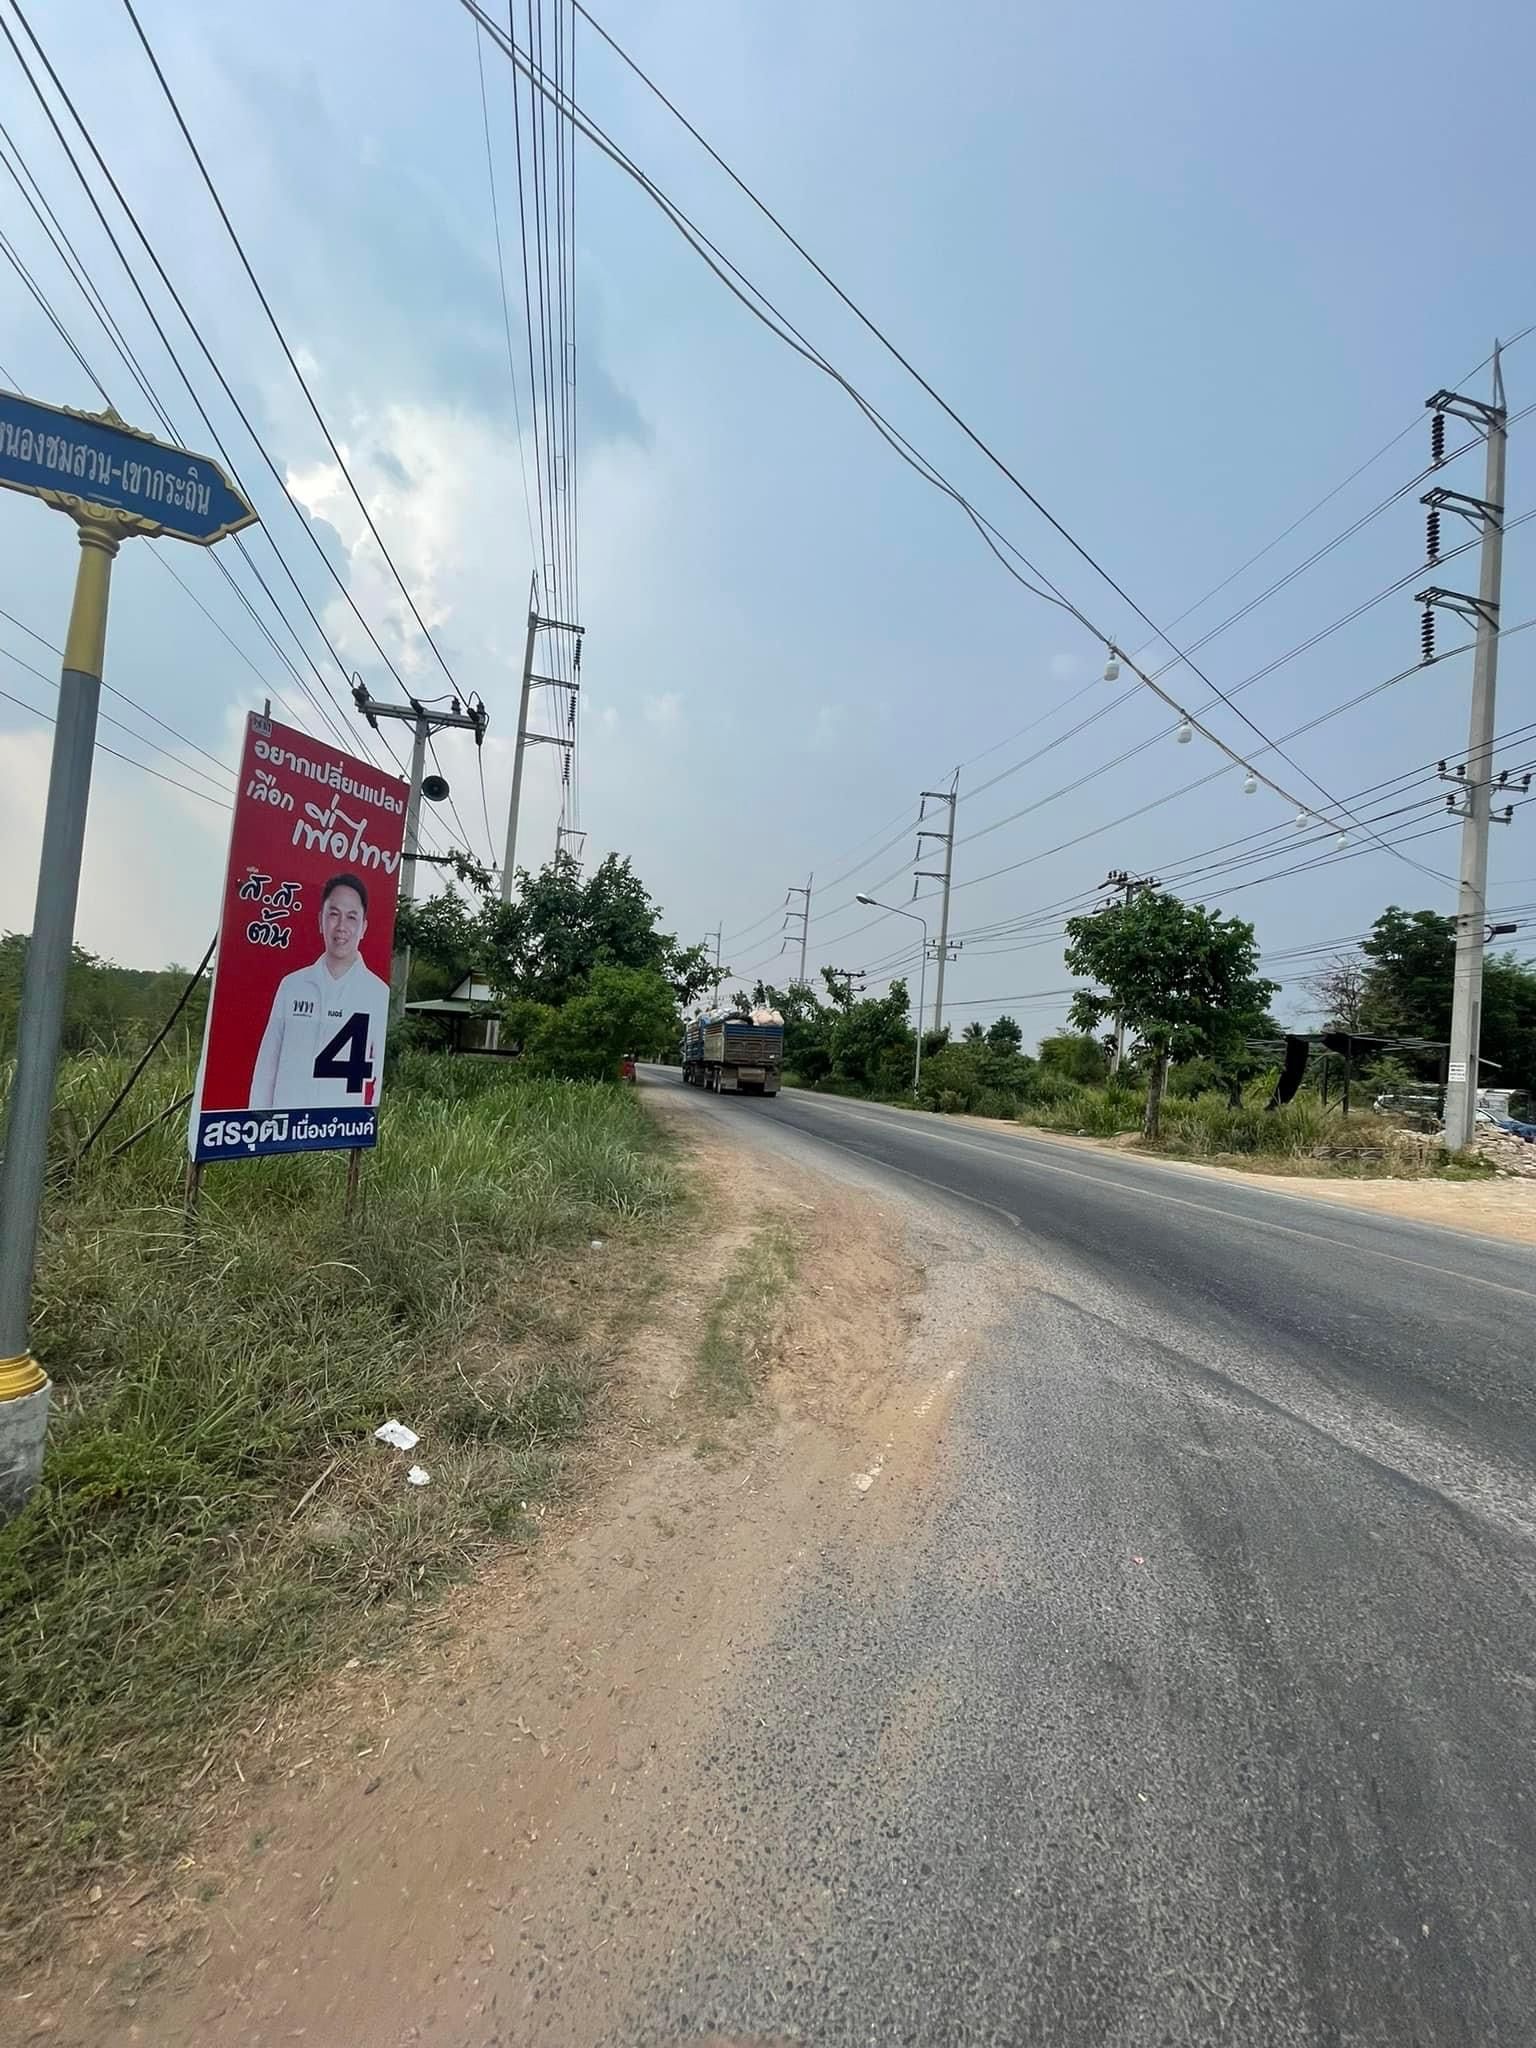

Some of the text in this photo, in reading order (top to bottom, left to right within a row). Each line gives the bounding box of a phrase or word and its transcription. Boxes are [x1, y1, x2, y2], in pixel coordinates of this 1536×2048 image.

[254, 740, 403, 815] อยากเปลี่ยนแปลง
[247, 769, 401, 874] เลือก เพื่อไทย
[240, 874, 302, 911] ส.ส.
[247, 908, 291, 948] ต้น
[313, 1012, 373, 1093] 4
[203, 1113, 374, 1151] สรวุฒิ เนื่องจำนงค์
